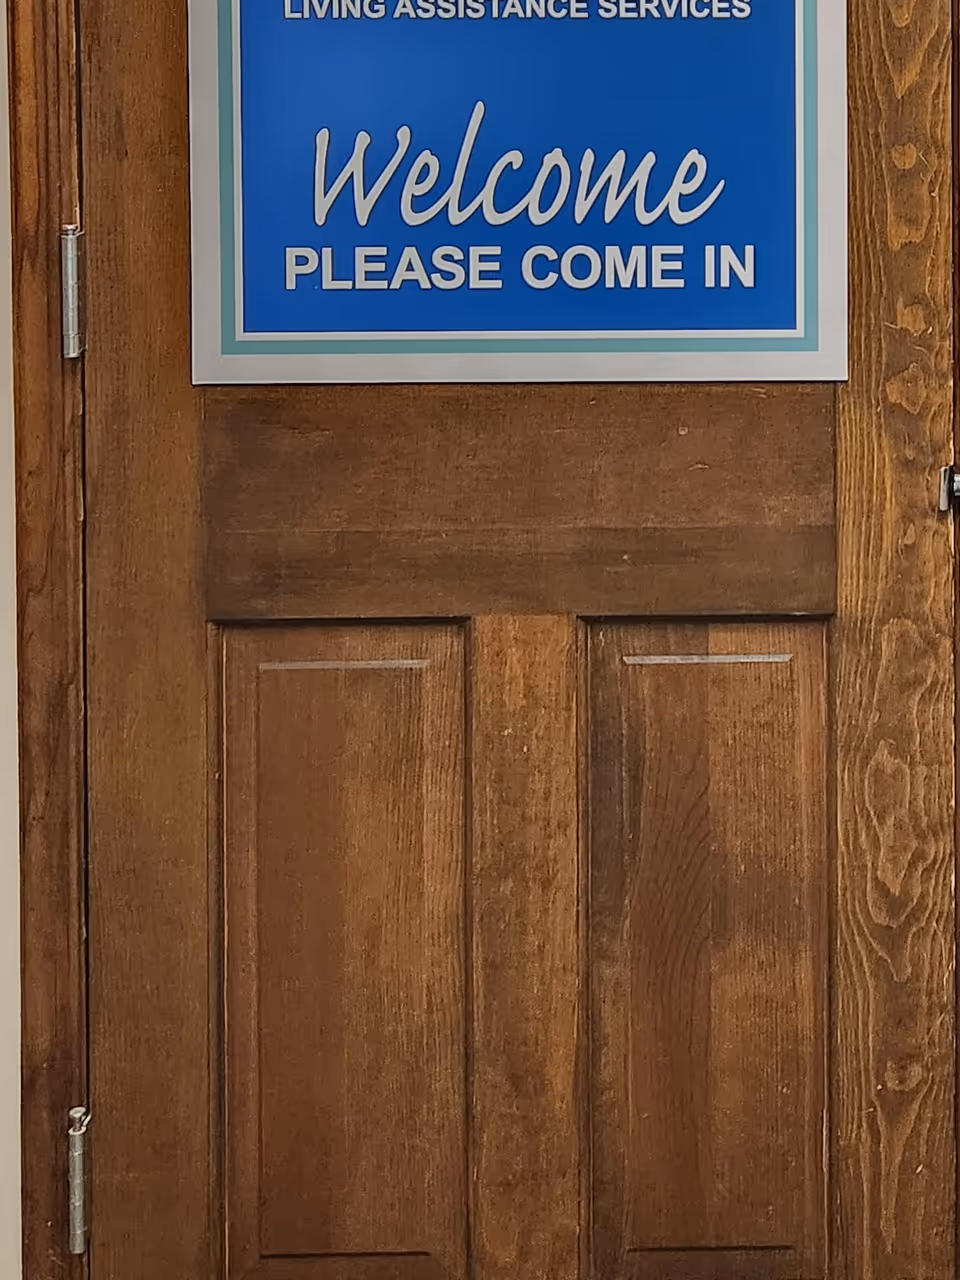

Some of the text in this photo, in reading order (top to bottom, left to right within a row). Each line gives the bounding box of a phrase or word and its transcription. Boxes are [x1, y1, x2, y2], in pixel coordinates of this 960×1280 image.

[313, 100, 726, 227] Welcome
[284, 244, 756, 291] PLEASE COME IN
